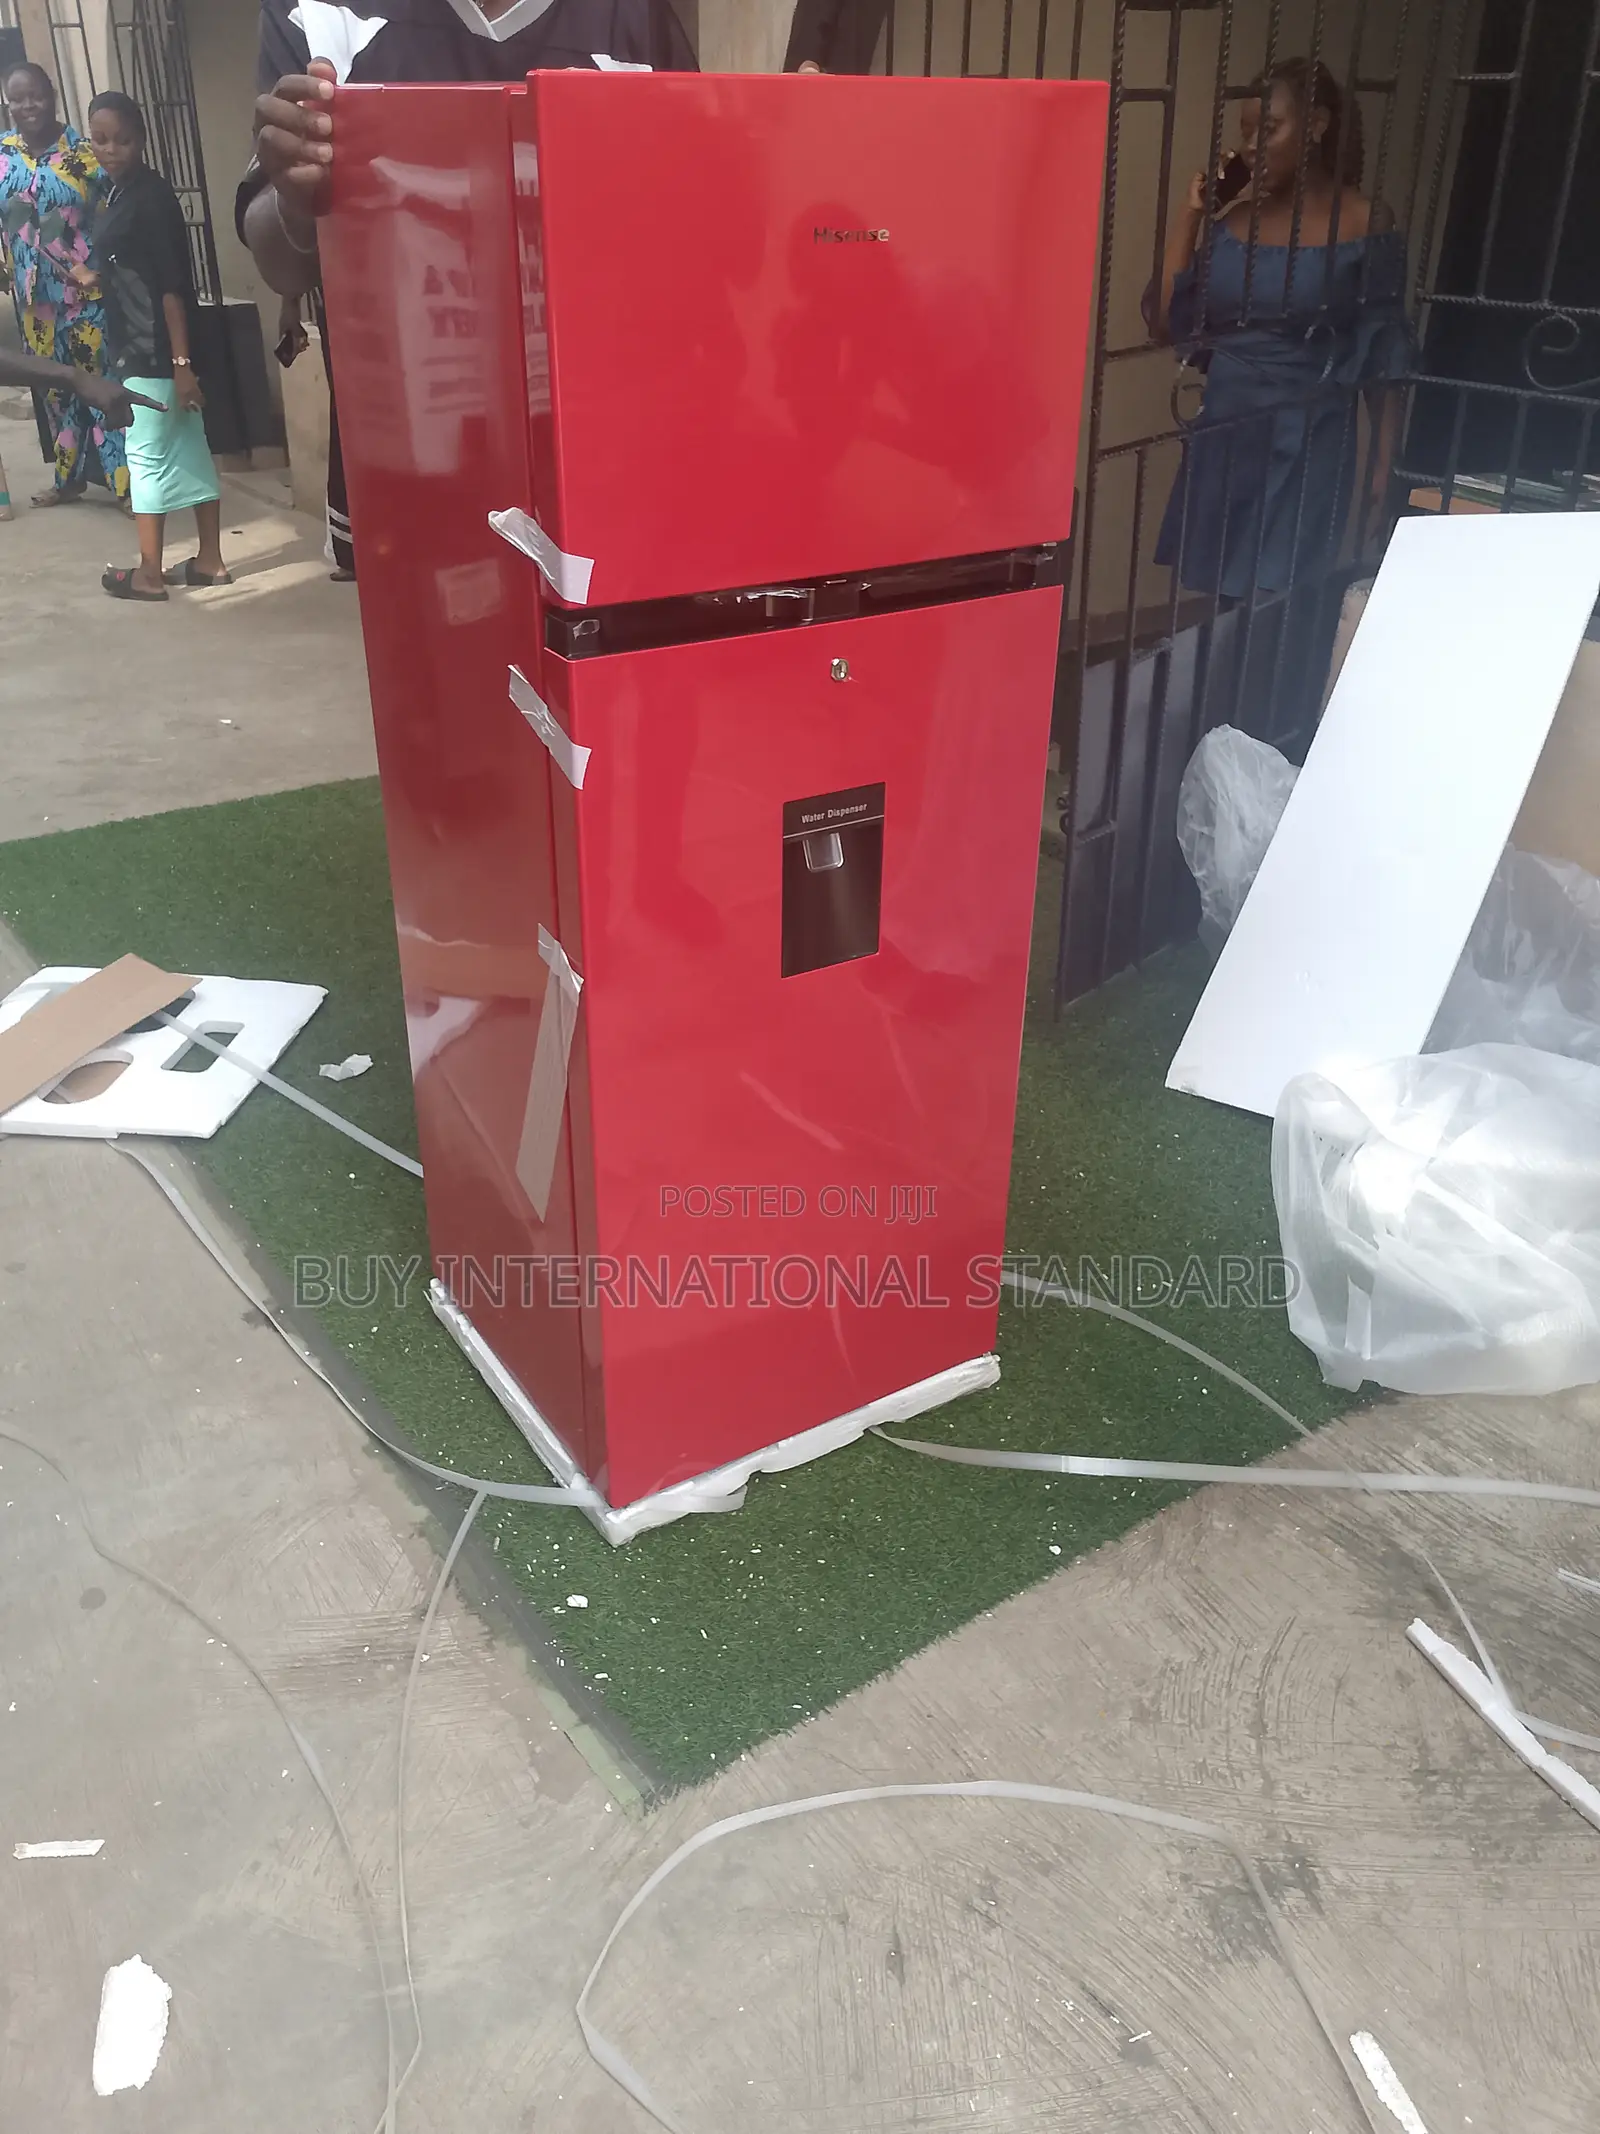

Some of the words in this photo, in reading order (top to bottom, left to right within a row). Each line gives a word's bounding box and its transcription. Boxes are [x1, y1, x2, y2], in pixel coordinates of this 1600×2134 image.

[813, 227, 890, 244] Hisense
[801, 812, 825, 824] Water
[827, 803, 868, 818] Dispenser
